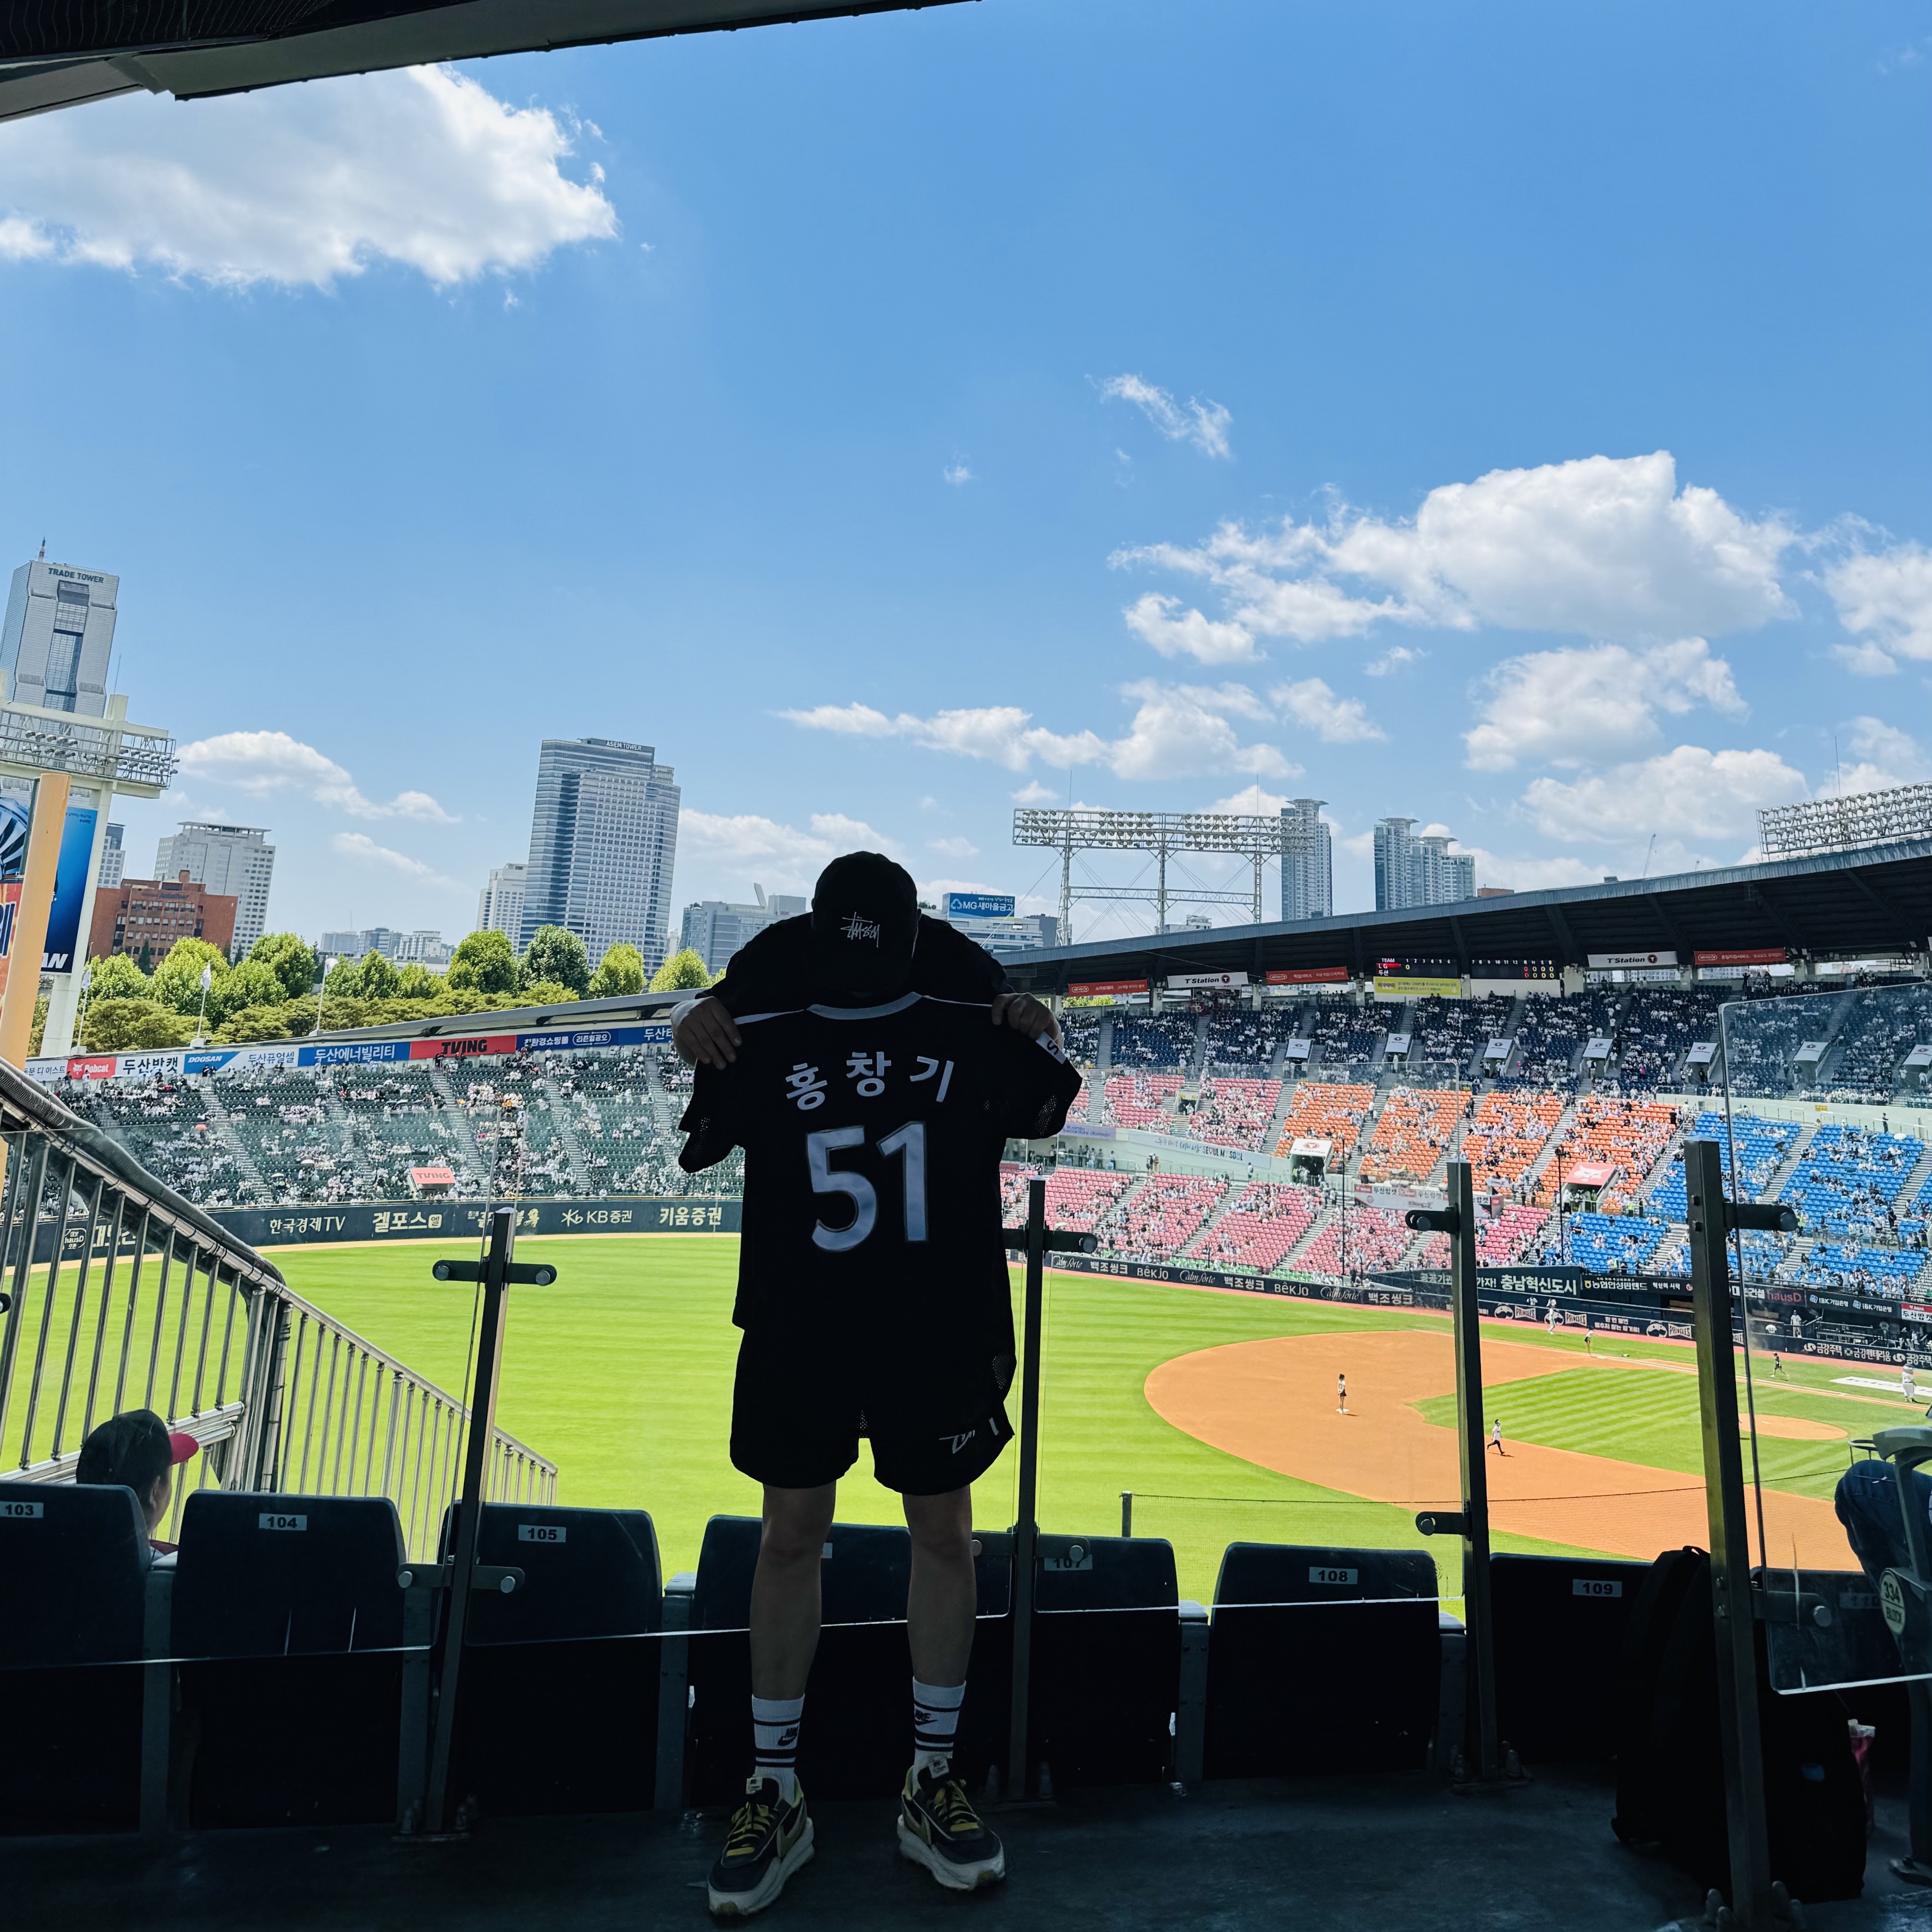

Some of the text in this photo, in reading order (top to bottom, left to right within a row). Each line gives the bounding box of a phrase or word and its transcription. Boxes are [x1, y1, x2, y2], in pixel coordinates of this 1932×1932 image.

[48, 568, 104, 583] TRADE TOWER
[315, 1045, 395, 1062] 두산에너빌리티
[441, 1039, 488, 1055] TVING
[248, 1051, 295, 1063] 두산퓨얼셀
[85, 1064, 109, 1073] Bobcat
[805, 1120, 929, 1252] 51
[1373, 1186, 1397, 1196] 두산밥캣
[586, 1209, 633, 1224] KB증권
[659, 1207, 722, 1226] 키움증권
[269, 1215, 346, 1234] 한국경제TV
[65, 1235, 84, 1244] hausD
[1090, 1261, 1128, 1275] 백조씽크
[1224, 1276, 1265, 1291] 백조씽크
[1500, 1274, 1577, 1295] 충남혁신도시
[1368, 1292, 1414, 1305] 백조씽크
[1767, 1290, 1802, 1303] hausD
[1816, 1343, 1843, 1356] 금강주택
[1853, 1347, 1891, 1362] 금강펜테리움
[1906, 1353, 1932, 1367] 금강주택
[5, 1503, 34, 1516] 103
[267, 1517, 298, 1528] 104
[528, 1529, 557, 1540] 105
[1318, 1570, 1348, 1582] 108
[1582, 1582, 1614, 1595] 109
[1884, 1581, 1900, 1604] 334
